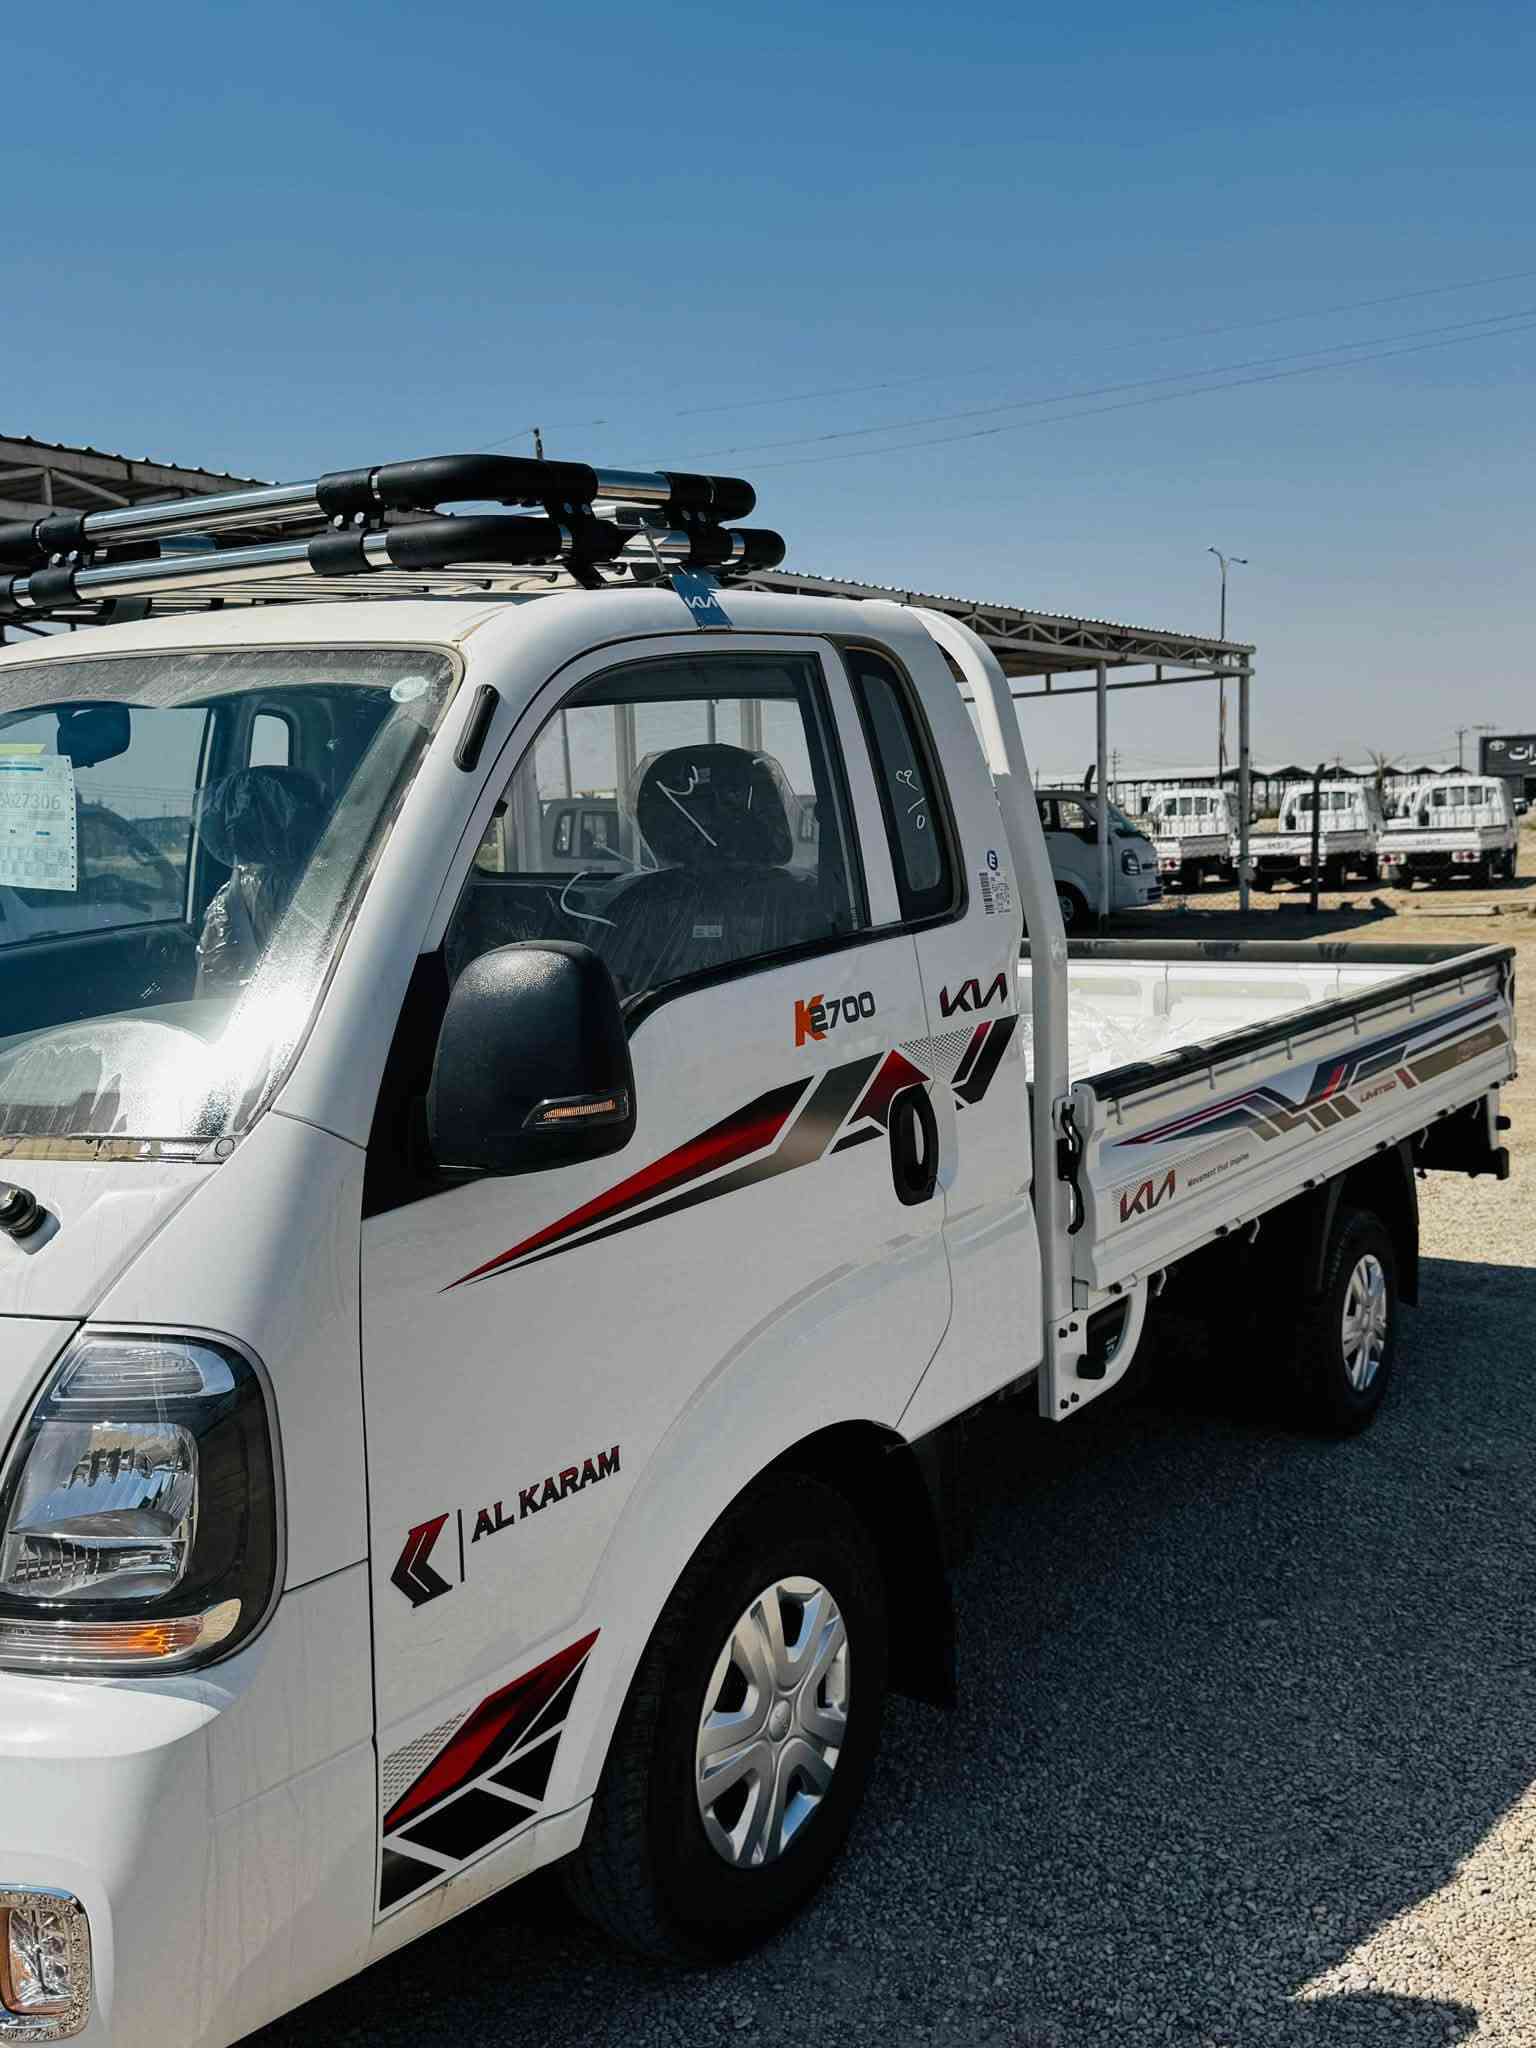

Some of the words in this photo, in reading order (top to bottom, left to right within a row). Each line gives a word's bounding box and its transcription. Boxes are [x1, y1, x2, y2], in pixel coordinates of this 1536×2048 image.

[794, 991, 875, 1047] K2700
[939, 972, 1008, 1018] KIA
[1120, 1169, 1175, 1223] KIA
[471, 1500, 515, 1544] AL
[518, 1444, 621, 1519] KARAM
